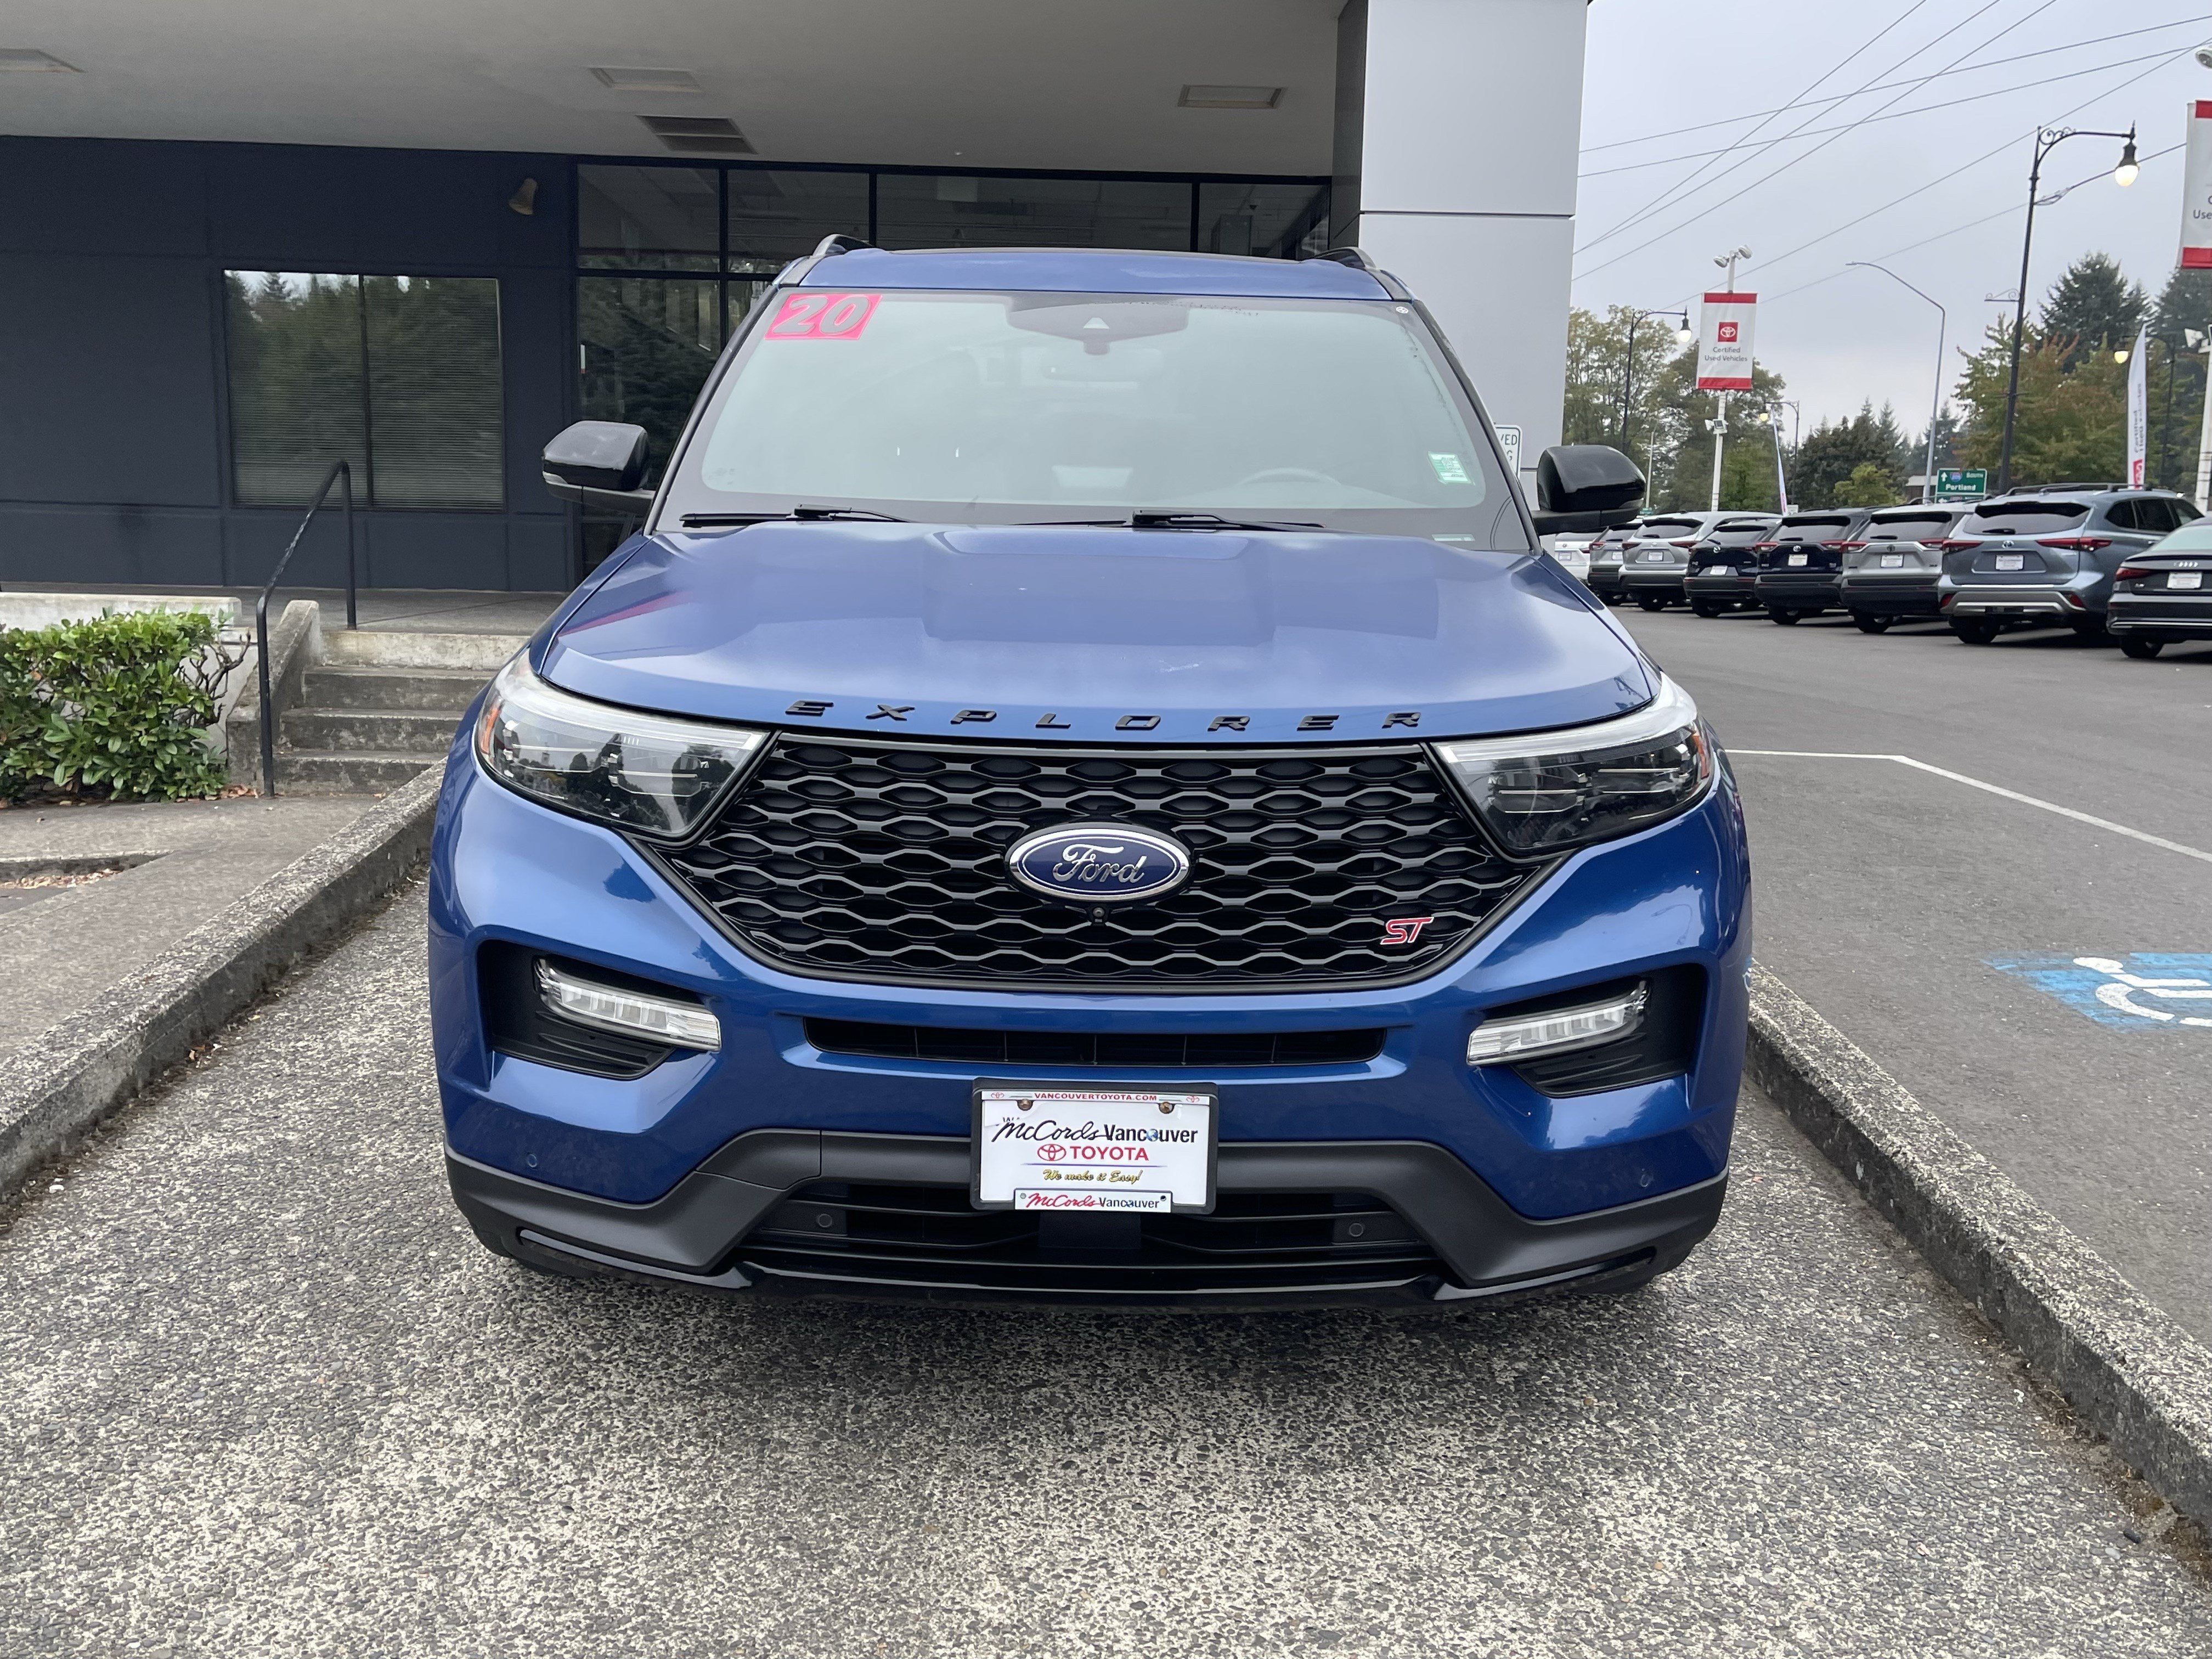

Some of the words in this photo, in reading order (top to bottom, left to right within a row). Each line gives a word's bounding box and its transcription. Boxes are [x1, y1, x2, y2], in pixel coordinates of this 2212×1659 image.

[772, 296, 870, 335] 20
[785, 700, 1421, 731] EXPLORER
[1052, 843, 1147, 883] Ford
[1380, 917, 1435, 945] ST
[1034, 1092, 1157, 1102] VANCOUVERTOYOTA.COM
[1070, 1146, 1149, 1161] TOYOTA
[1043, 1169, 1062, 1181] We
[1064, 1170, 1094, 1181] make
[1097, 1171, 1108, 1181] it
[1109, 1169, 1143, 1184] Easy!
